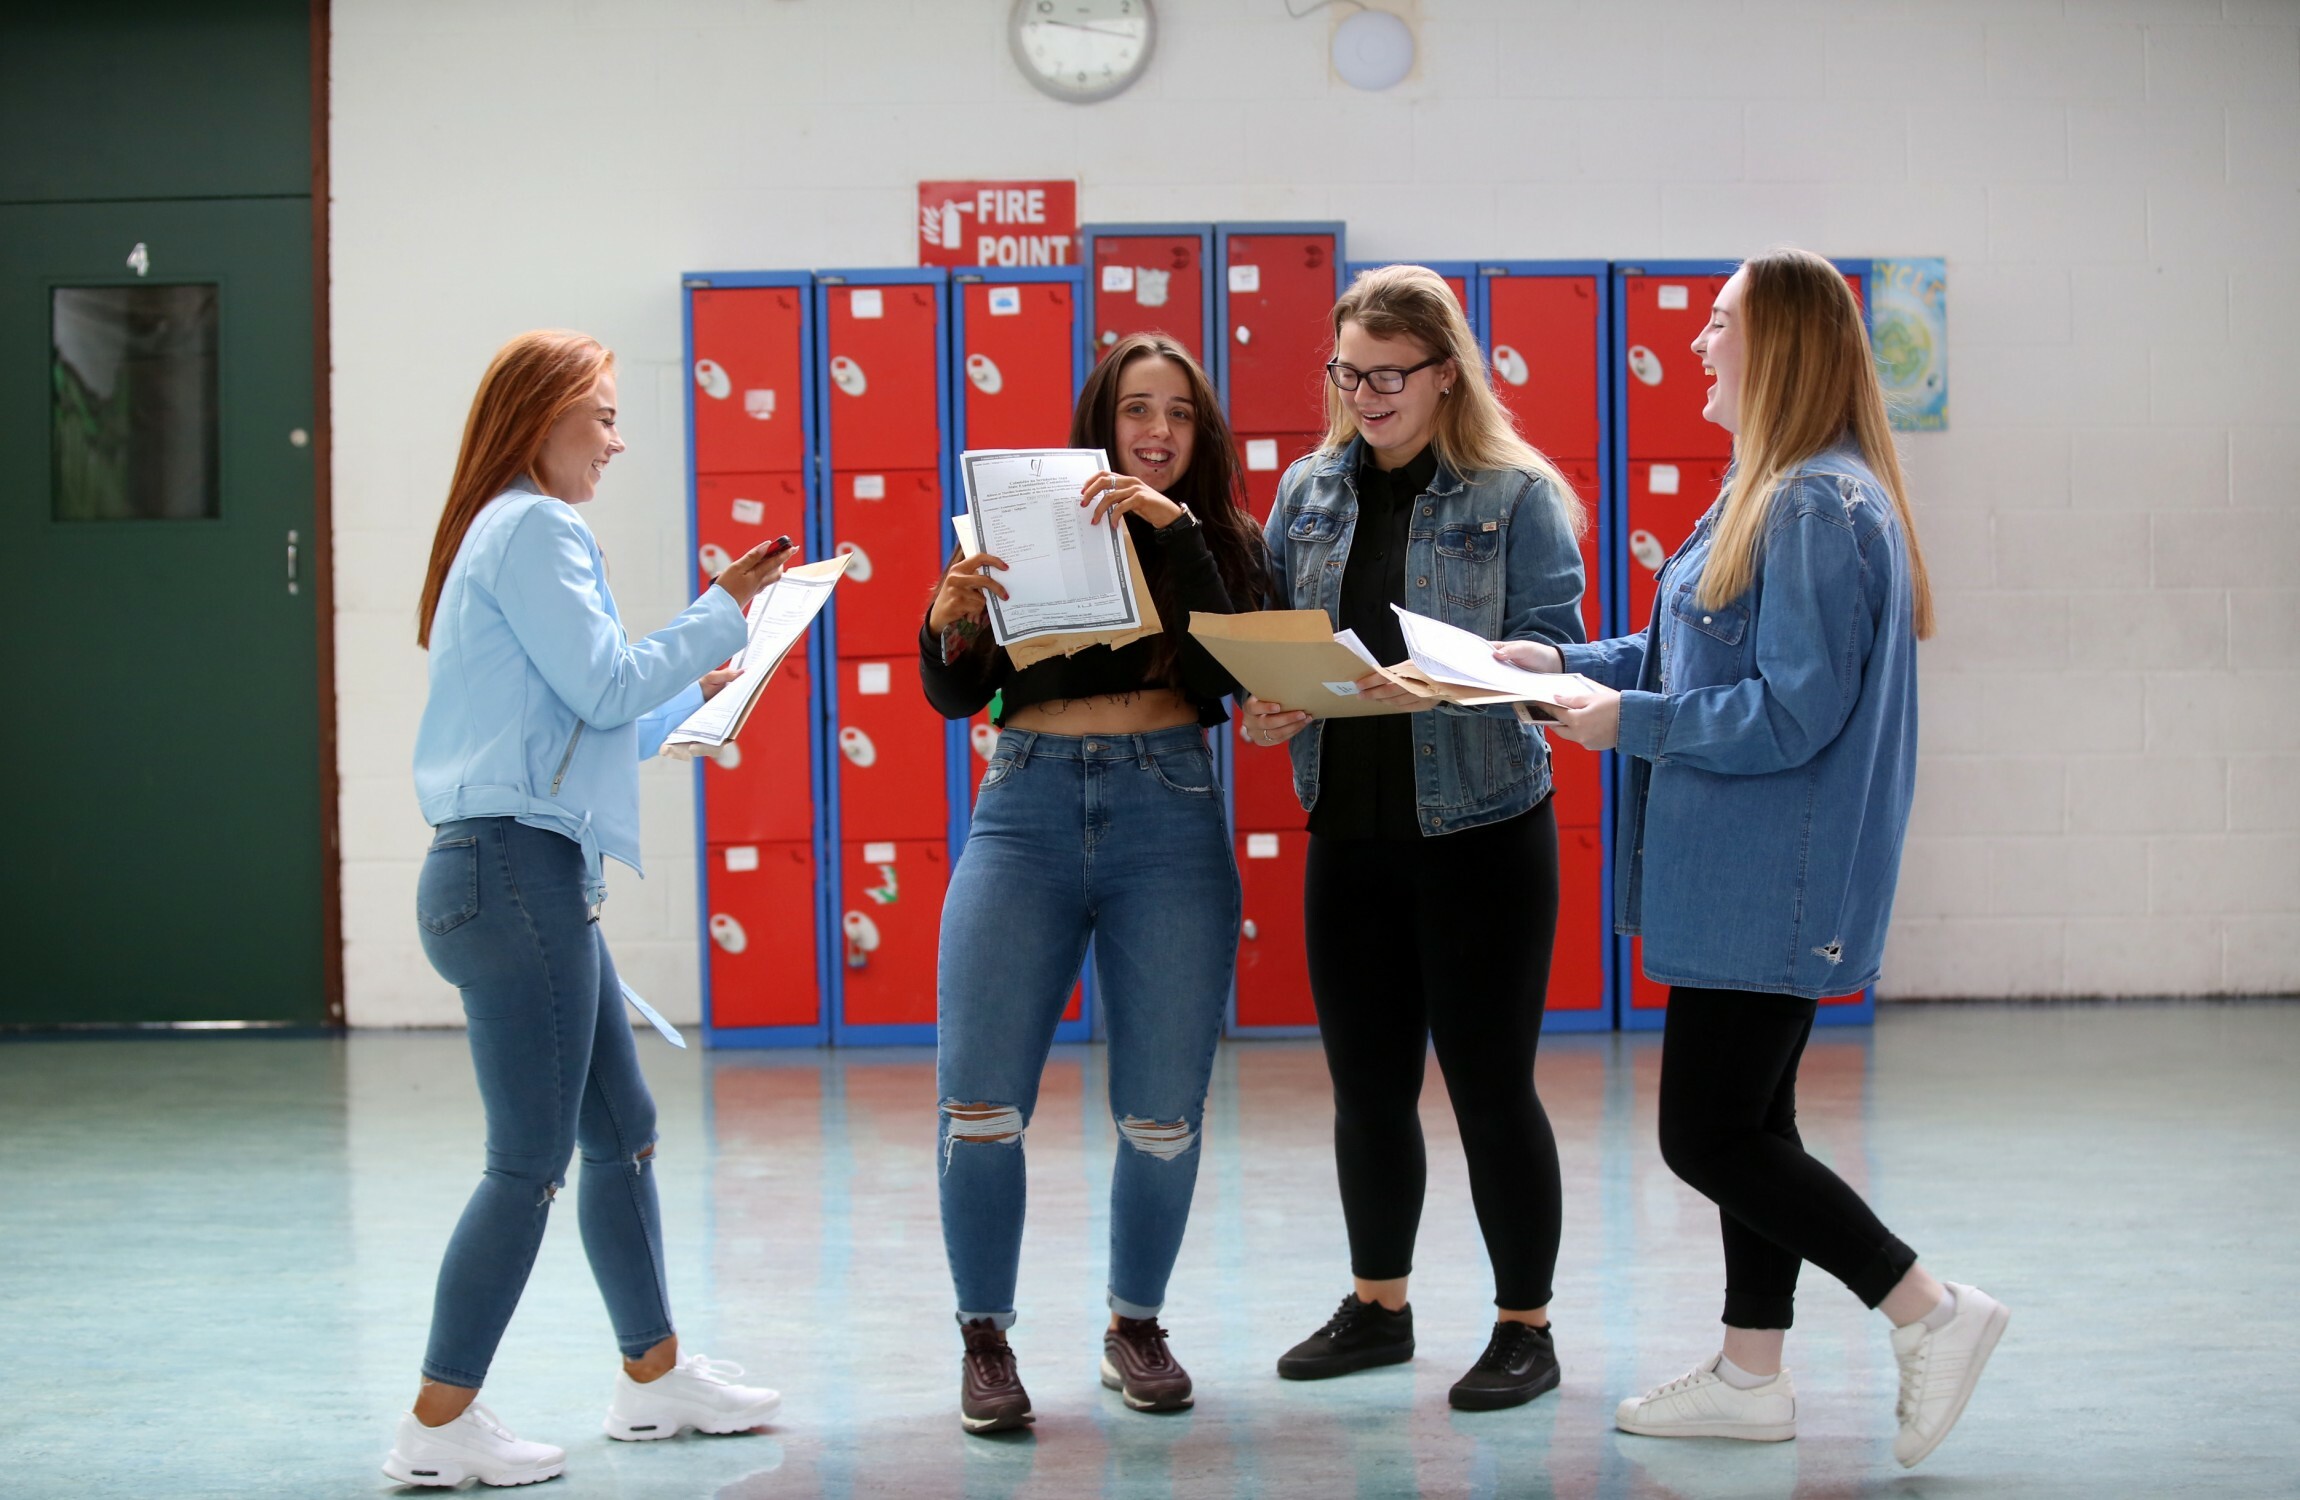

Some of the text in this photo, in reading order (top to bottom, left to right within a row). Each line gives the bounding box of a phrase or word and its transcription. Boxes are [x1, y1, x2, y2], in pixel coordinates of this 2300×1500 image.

[977, 189, 1046, 224] FIRE
[126, 242, 149, 277] 4
[977, 235, 1071, 267] POINT
